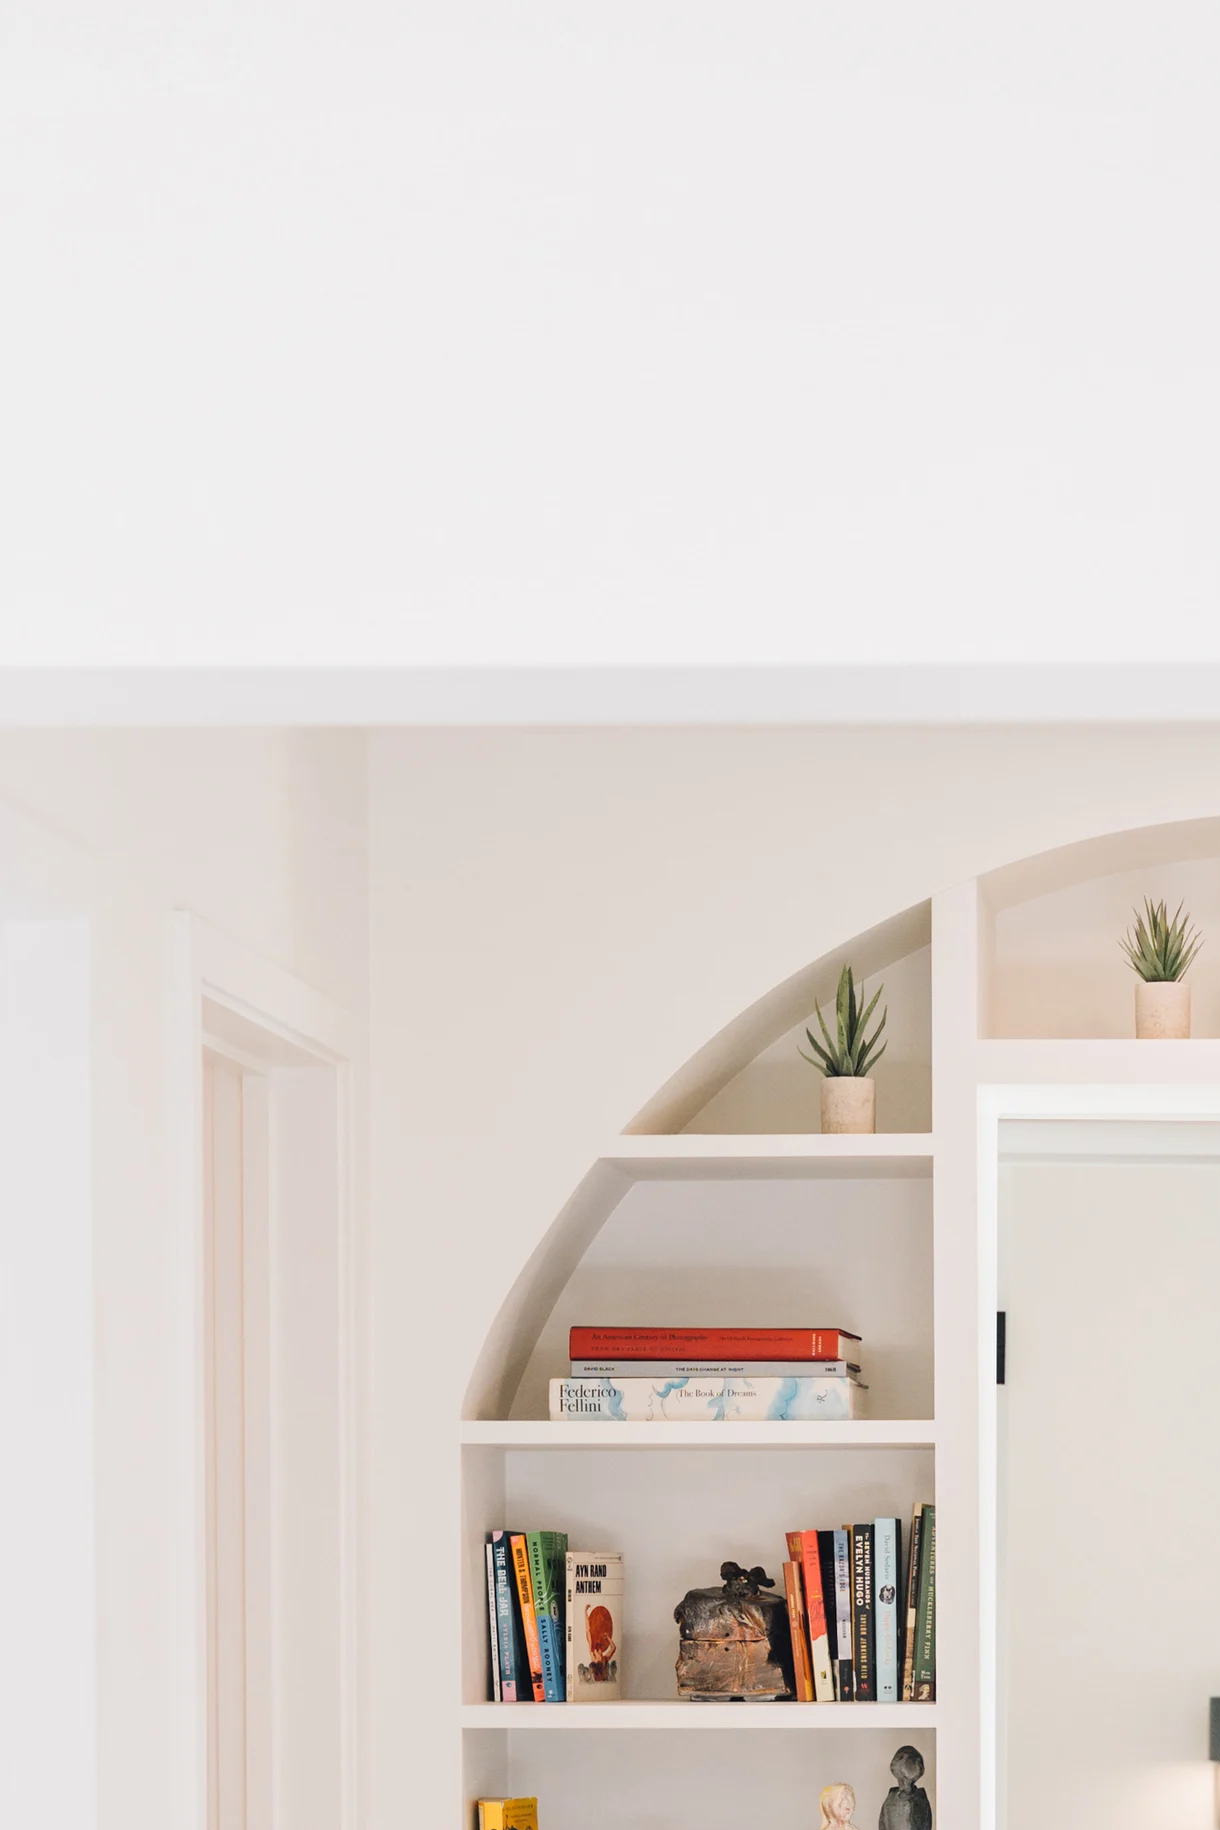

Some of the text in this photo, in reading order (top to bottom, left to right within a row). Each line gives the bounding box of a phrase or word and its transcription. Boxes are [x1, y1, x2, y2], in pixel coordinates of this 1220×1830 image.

[560, 1384, 617, 1398] Federico
[680, 1389, 756, 1398] The Book of Dreams
[560, 1399, 601, 1412] Fellini
[496, 1546, 506, 1566] THE
[576, 1564, 606, 1578] AYN RAND
[855, 1536, 864, 1606] EVELYN HUGO
[498, 1570, 507, 1593] BELL
[576, 1580, 602, 1594] ANTHEM
[536, 1580, 545, 1611] PEOPLE
[540, 1618, 553, 1682] SALLY ROONEY
[860, 1637, 868, 1662] JENKINS
[860, 1665, 868, 1679] REID
